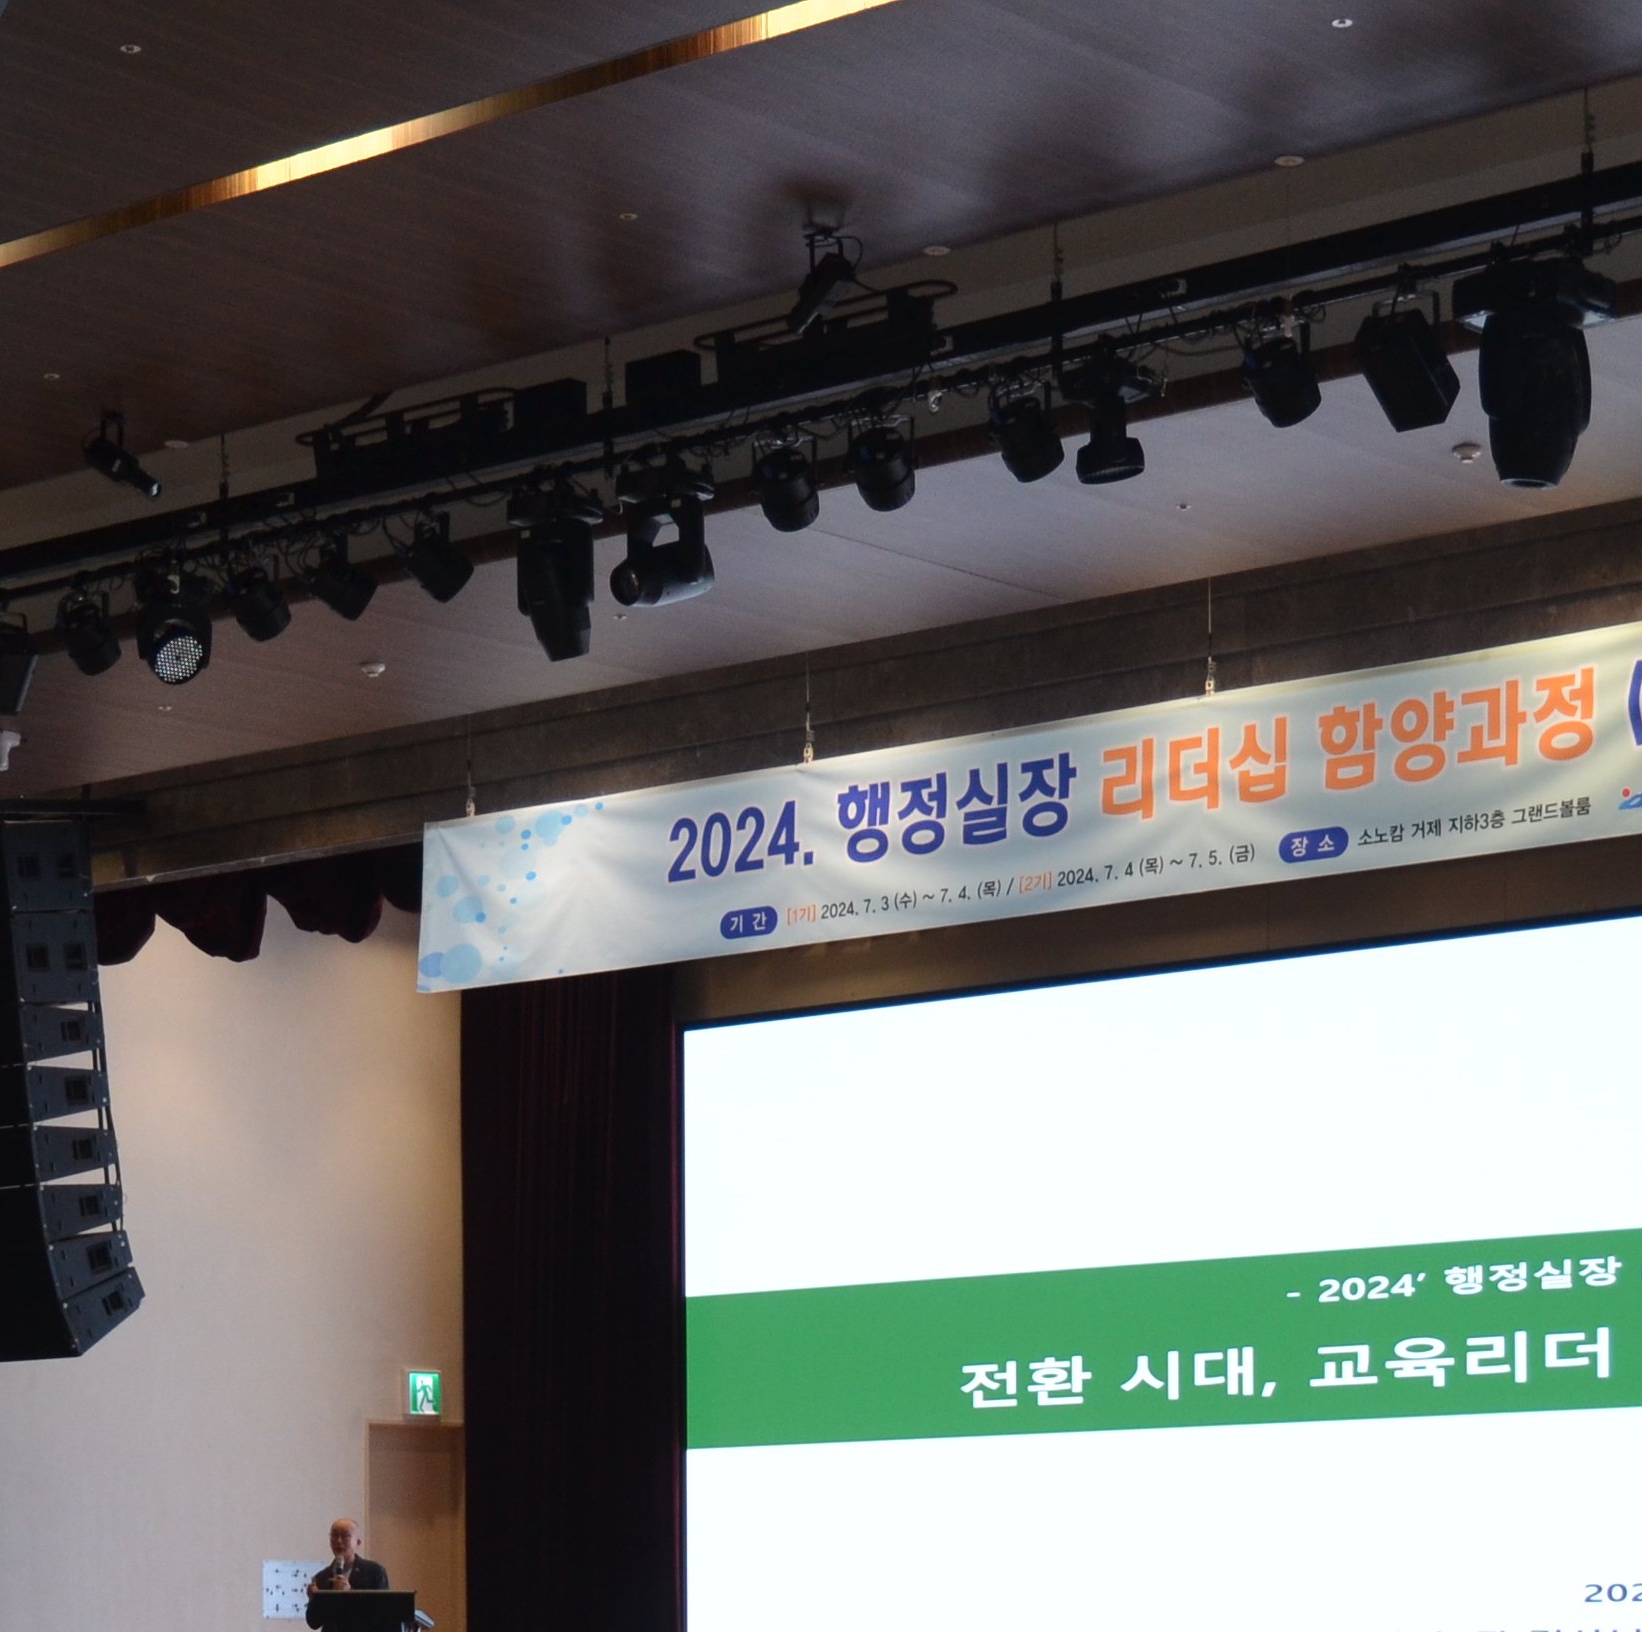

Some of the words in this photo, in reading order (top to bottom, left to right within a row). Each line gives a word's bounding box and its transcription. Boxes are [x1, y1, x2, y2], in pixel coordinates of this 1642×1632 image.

[668, 799, 814, 884] 2024.
[837, 751, 1077, 864] 행정실장
[1101, 715, 1288, 819] 리더십
[1319, 667, 1595, 791] 함양과정
[1357, 825, 1405, 847] 소노캄
[1411, 819, 1442, 840] 거제
[1448, 809, 1505, 834] 지하3층
[1511, 796, 1591, 825] 그랜드볼룸
[787, 904, 817, 926] [1기]
[821, 900, 859, 920] 2024.
[863, 899, 876, 915] 7.
[894, 890, 917, 911] (수)
[940, 888, 952, 904] 7.
[958, 885, 971, 901] 4.
[977, 879, 1002, 900] (목)
[1019, 871, 1053, 894] [2기]
[1057, 868, 1099, 888] 2024.
[1104, 864, 1118, 881] 7.
[1139, 855, 1164, 878] (목)
[1189, 853, 1203, 870] 7.
[1208, 849, 1223, 867] 5.
[1229, 842, 1255, 865] (금)
[1444, 1255, 1623, 1296] 행정실장
[960, 1355, 1092, 1408] 전환
[1120, 1346, 1277, 1400] 시대,
[1309, 1326, 1610, 1387] 교육리더
